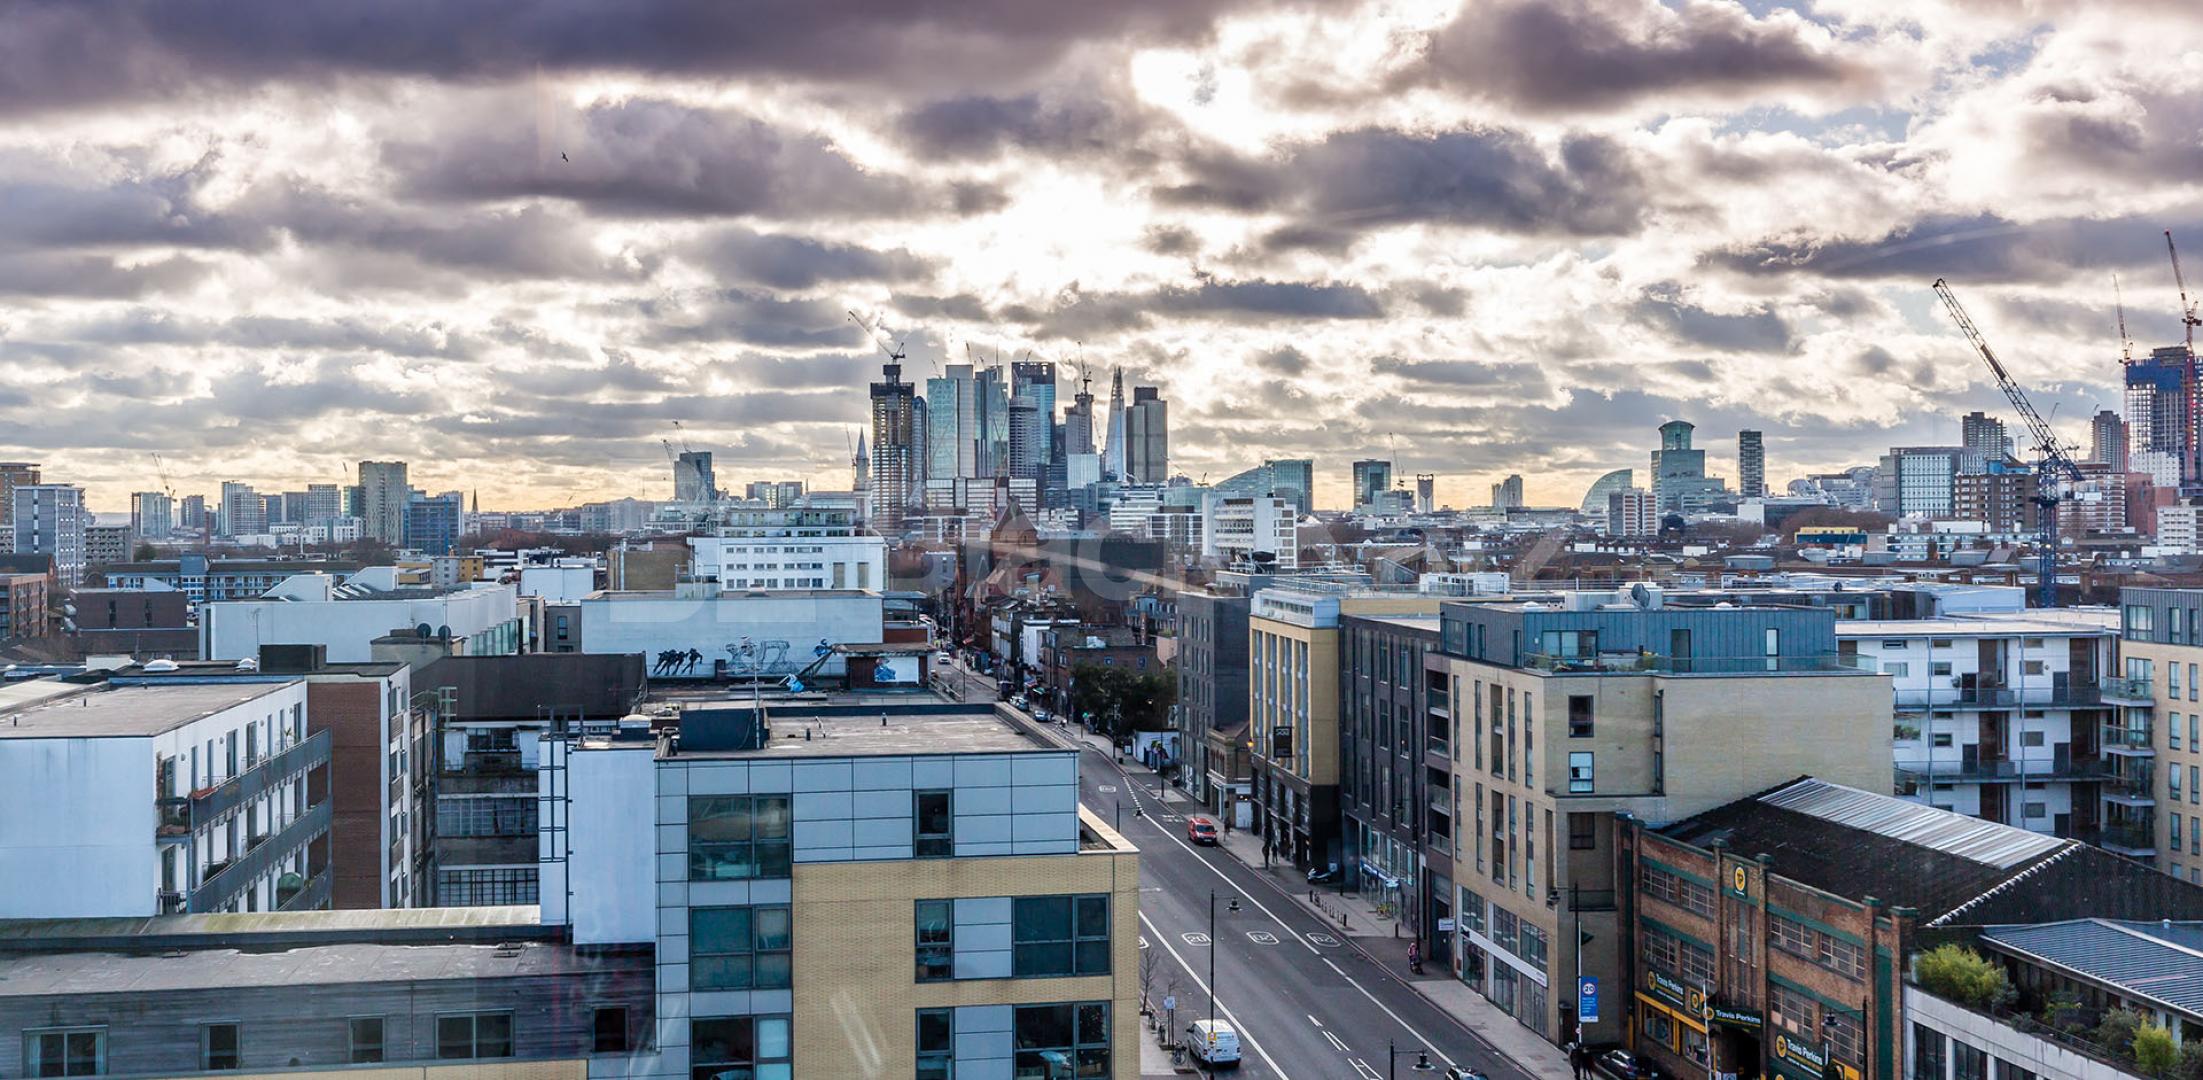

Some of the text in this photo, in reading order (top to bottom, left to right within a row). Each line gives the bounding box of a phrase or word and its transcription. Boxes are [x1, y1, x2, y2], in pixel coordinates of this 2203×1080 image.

[1715, 1009, 1735, 1019] Travis
[1735, 1012, 1761, 1024] Perkins
[1786, 1038, 1802, 1055] Travis
[1802, 1046, 1823, 1066] Perkins
